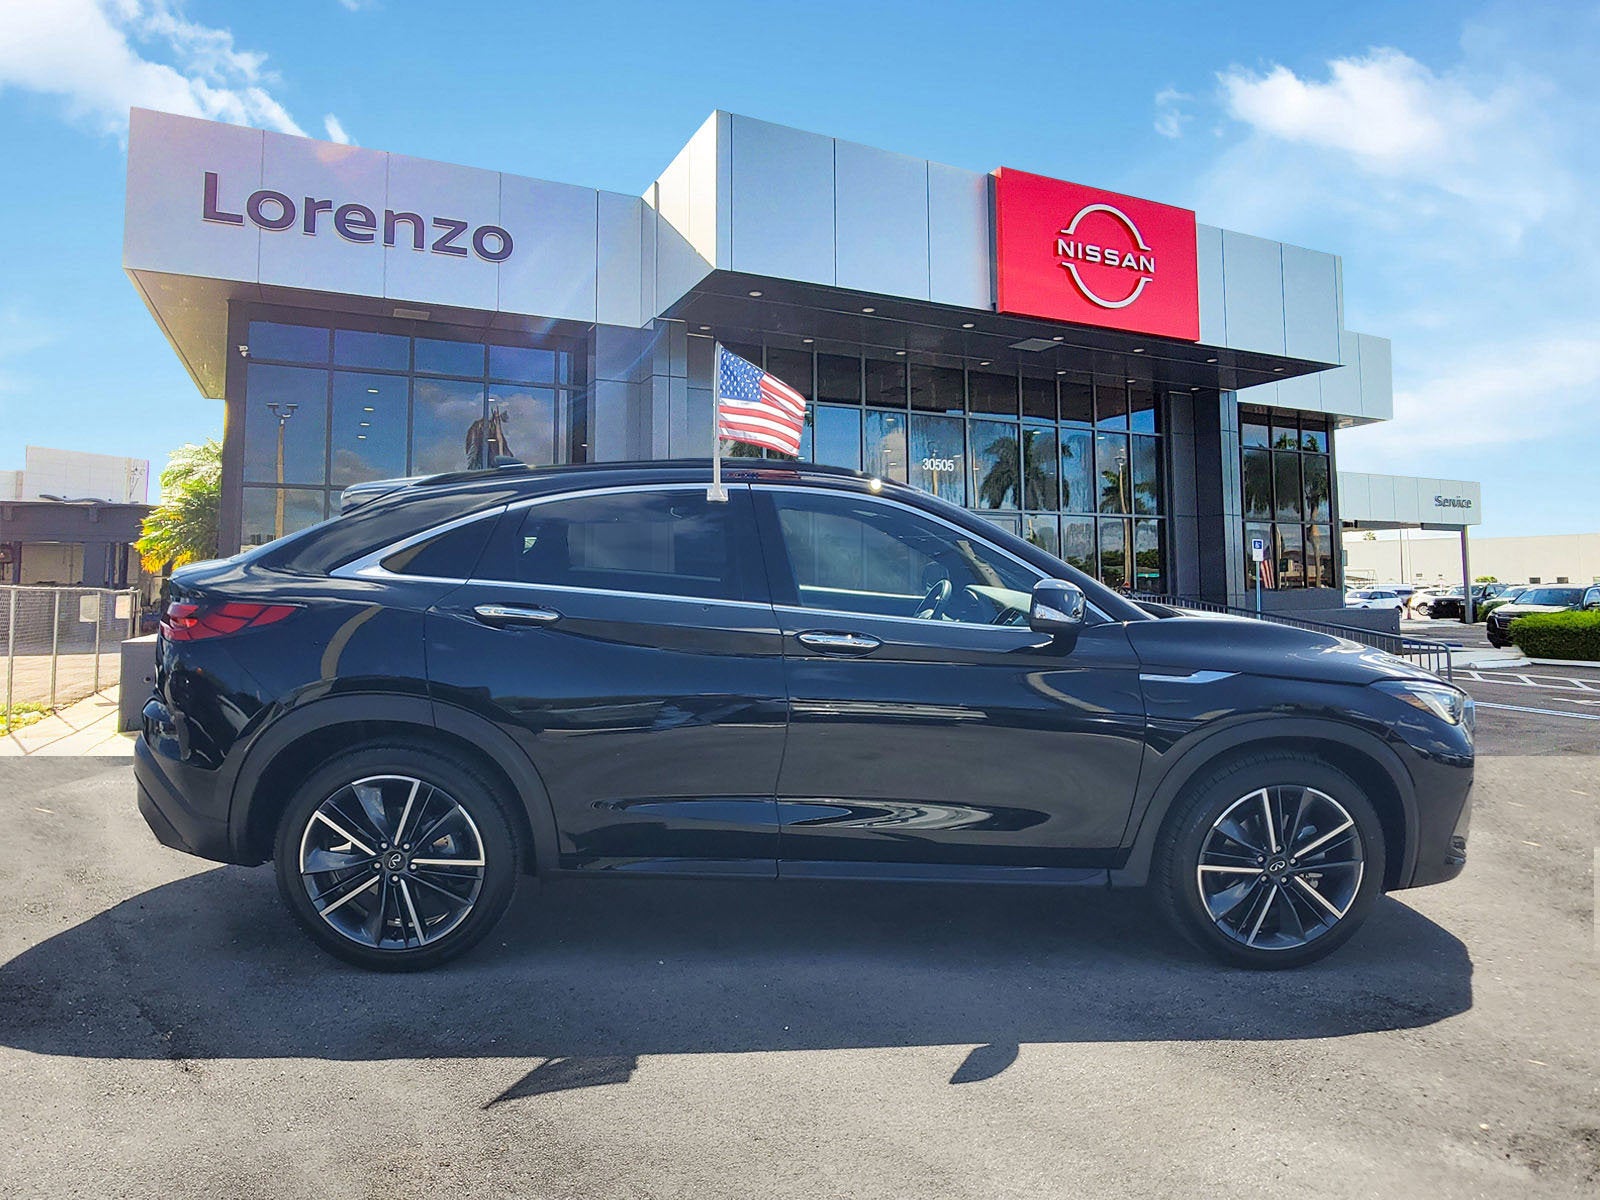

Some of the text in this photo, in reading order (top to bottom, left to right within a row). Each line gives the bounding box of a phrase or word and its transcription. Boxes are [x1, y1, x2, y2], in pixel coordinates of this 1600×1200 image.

[203, 171, 514, 262] Lorenzo
[1057, 238, 1155, 273] NISSAN
[922, 458, 955, 471] 30505
[1434, 495, 1472, 508] Service
